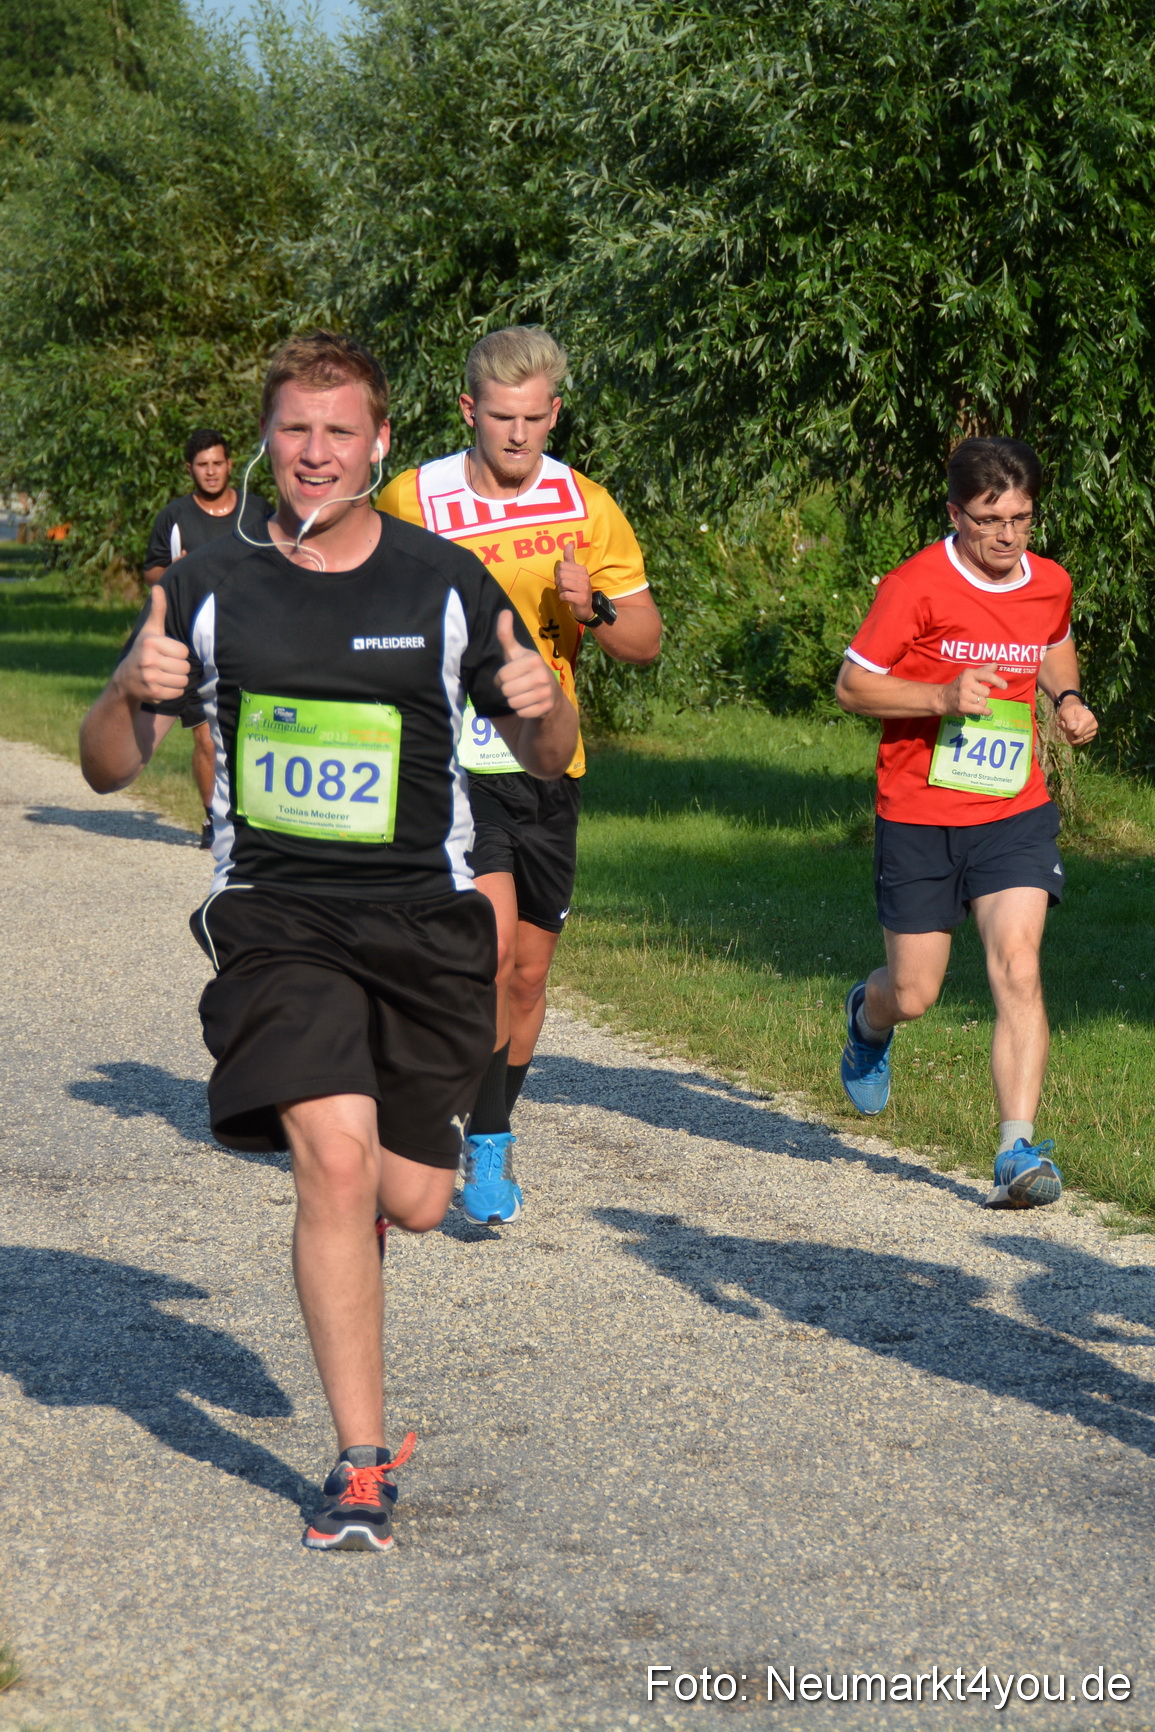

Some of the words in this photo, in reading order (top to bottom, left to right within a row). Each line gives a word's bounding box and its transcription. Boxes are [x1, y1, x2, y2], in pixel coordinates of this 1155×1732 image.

[470, 543, 504, 565] X
[513, 530, 591, 559] BÖGL
[365, 636, 426, 650] PFLEIDERER
[941, 639, 1038, 662] NEUMARKT
[999, 666, 1022, 674] STARKE
[471, 716, 502, 746] 9
[480, 752, 500, 760] Marco
[949, 733, 1025, 771] 1407
[255, 751, 381, 804] 1082
[951, 769, 977, 779] Gerhard
[278, 804, 309, 817] Tobias
[310, 809, 350, 821] Mederer
